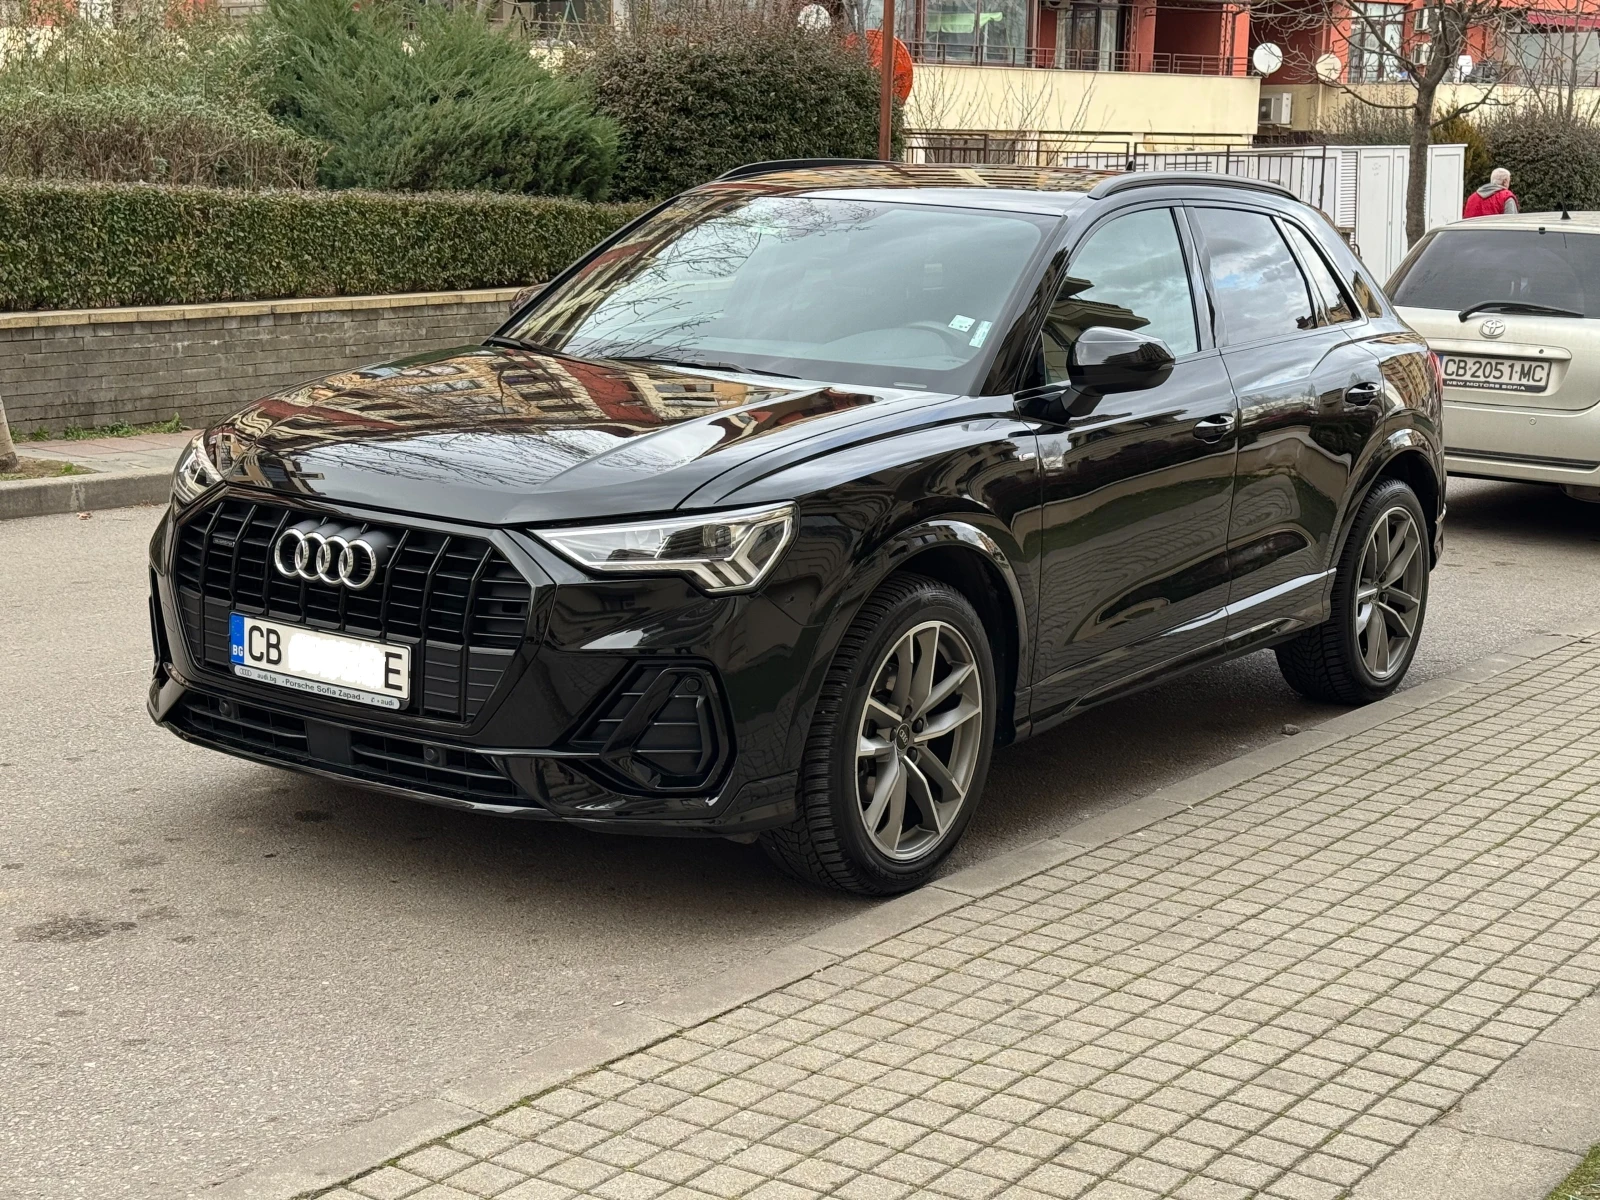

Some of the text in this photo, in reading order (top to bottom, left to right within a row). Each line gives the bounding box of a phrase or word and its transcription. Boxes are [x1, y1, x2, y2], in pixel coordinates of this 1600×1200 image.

[1443, 359, 1545, 382] CB 2051 MC
[232, 644, 243, 657] BG
[248, 625, 403, 691] CB E
[285, 678, 315, 691] Porsche
[317, 685, 336, 695] Sofia
[338, 689, 361, 700] Zapad
